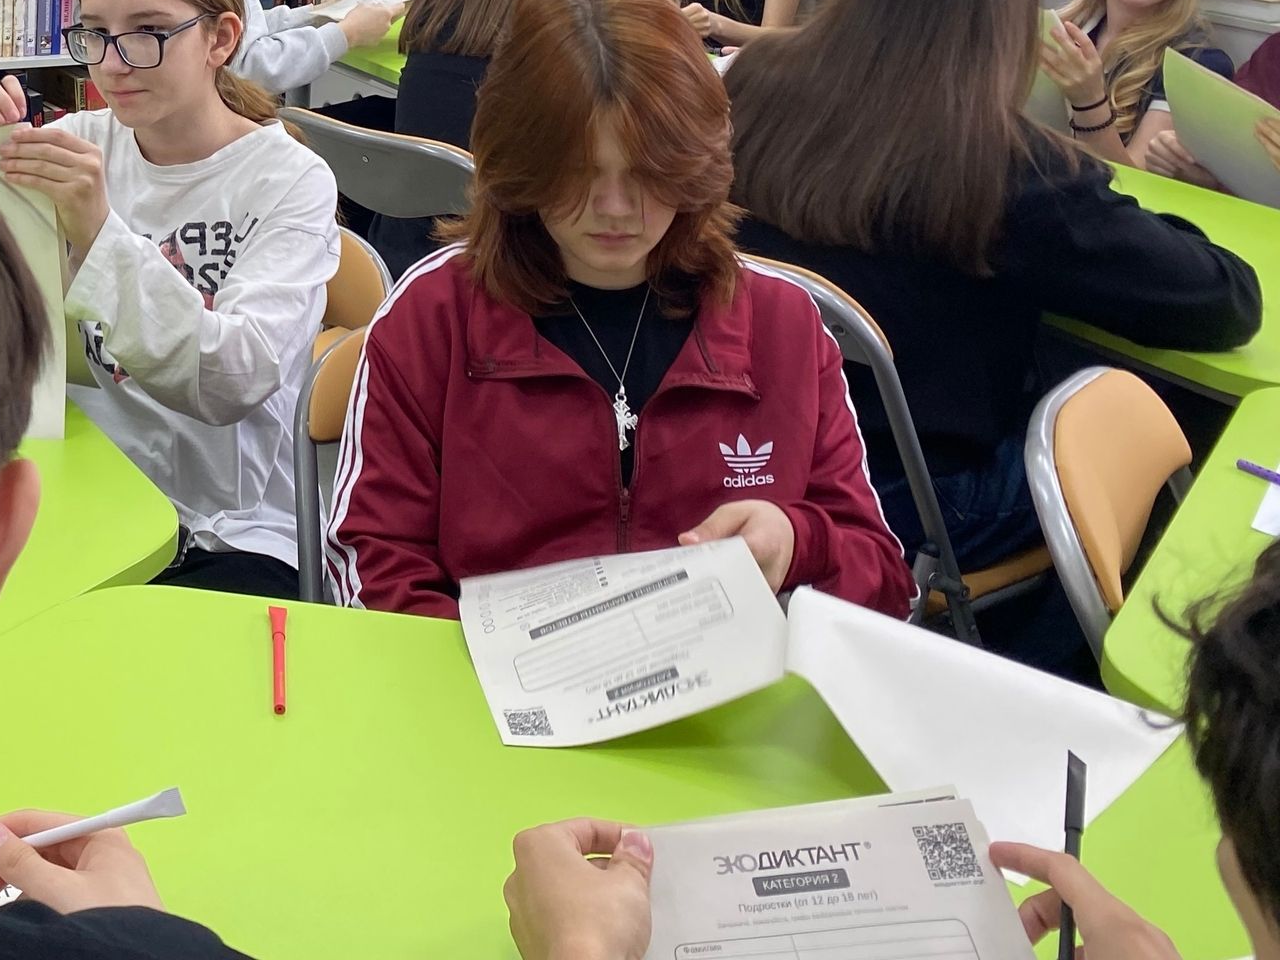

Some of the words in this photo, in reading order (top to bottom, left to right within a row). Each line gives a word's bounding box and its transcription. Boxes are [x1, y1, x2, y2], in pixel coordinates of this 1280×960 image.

[723, 474, 775, 488] adidas
[540, 614, 579, 635] ОТВЕТОВ
[713, 842, 862, 876] ЭКОДИКТАНТ
[762, 874, 830, 891] КАТЕГОРИЯ
[831, 873, 839, 884] 2
[738, 899, 792, 915] Подростки
[811, 895, 823, 906] 12
[826, 896, 840, 908] до
